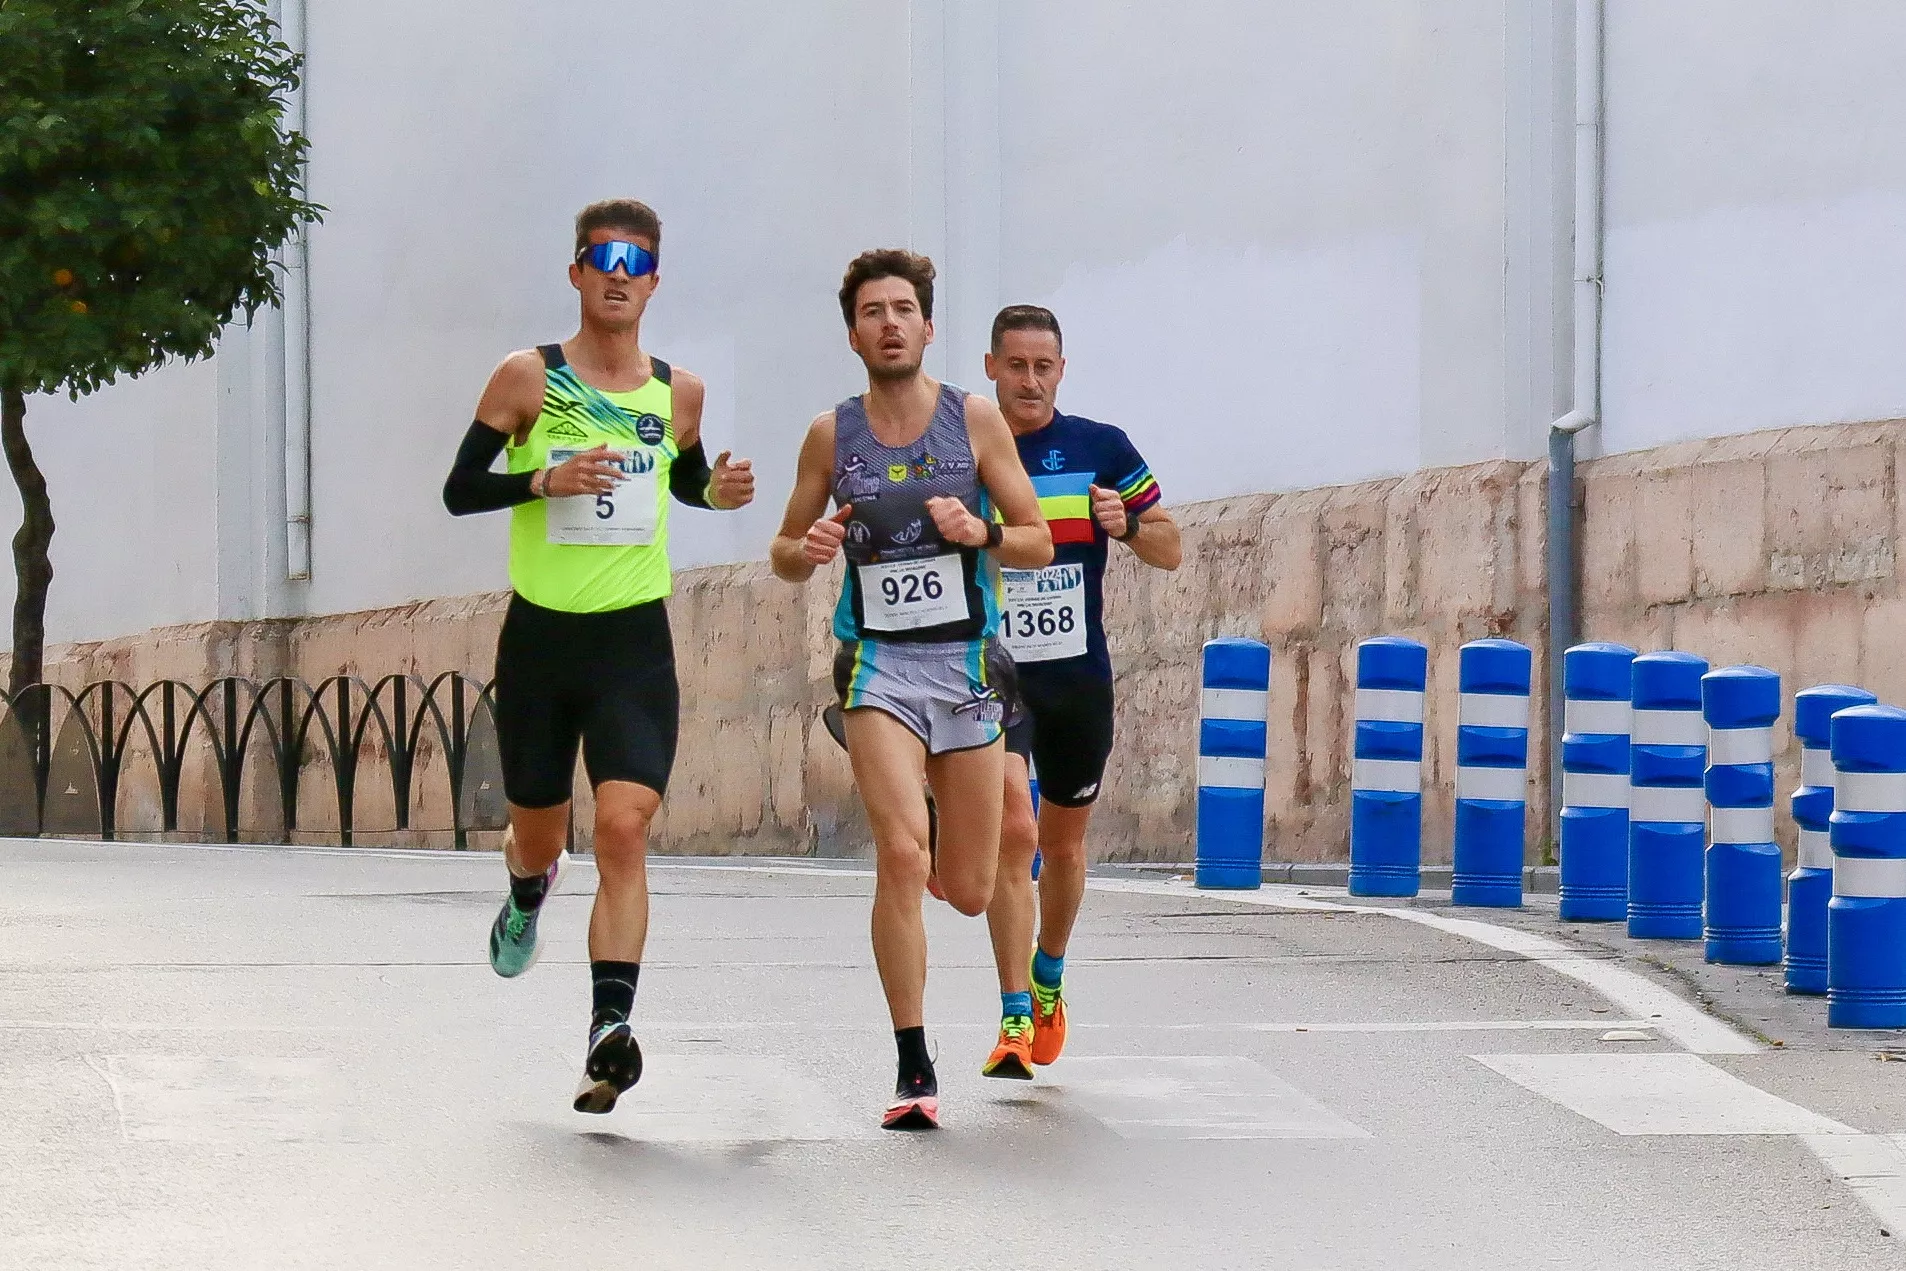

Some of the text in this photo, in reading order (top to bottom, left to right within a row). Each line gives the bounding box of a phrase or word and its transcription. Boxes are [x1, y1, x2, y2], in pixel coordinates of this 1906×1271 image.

[595, 491, 615, 519] 5
[881, 570, 943, 606] 926
[1000, 605, 1075, 639] 1368
